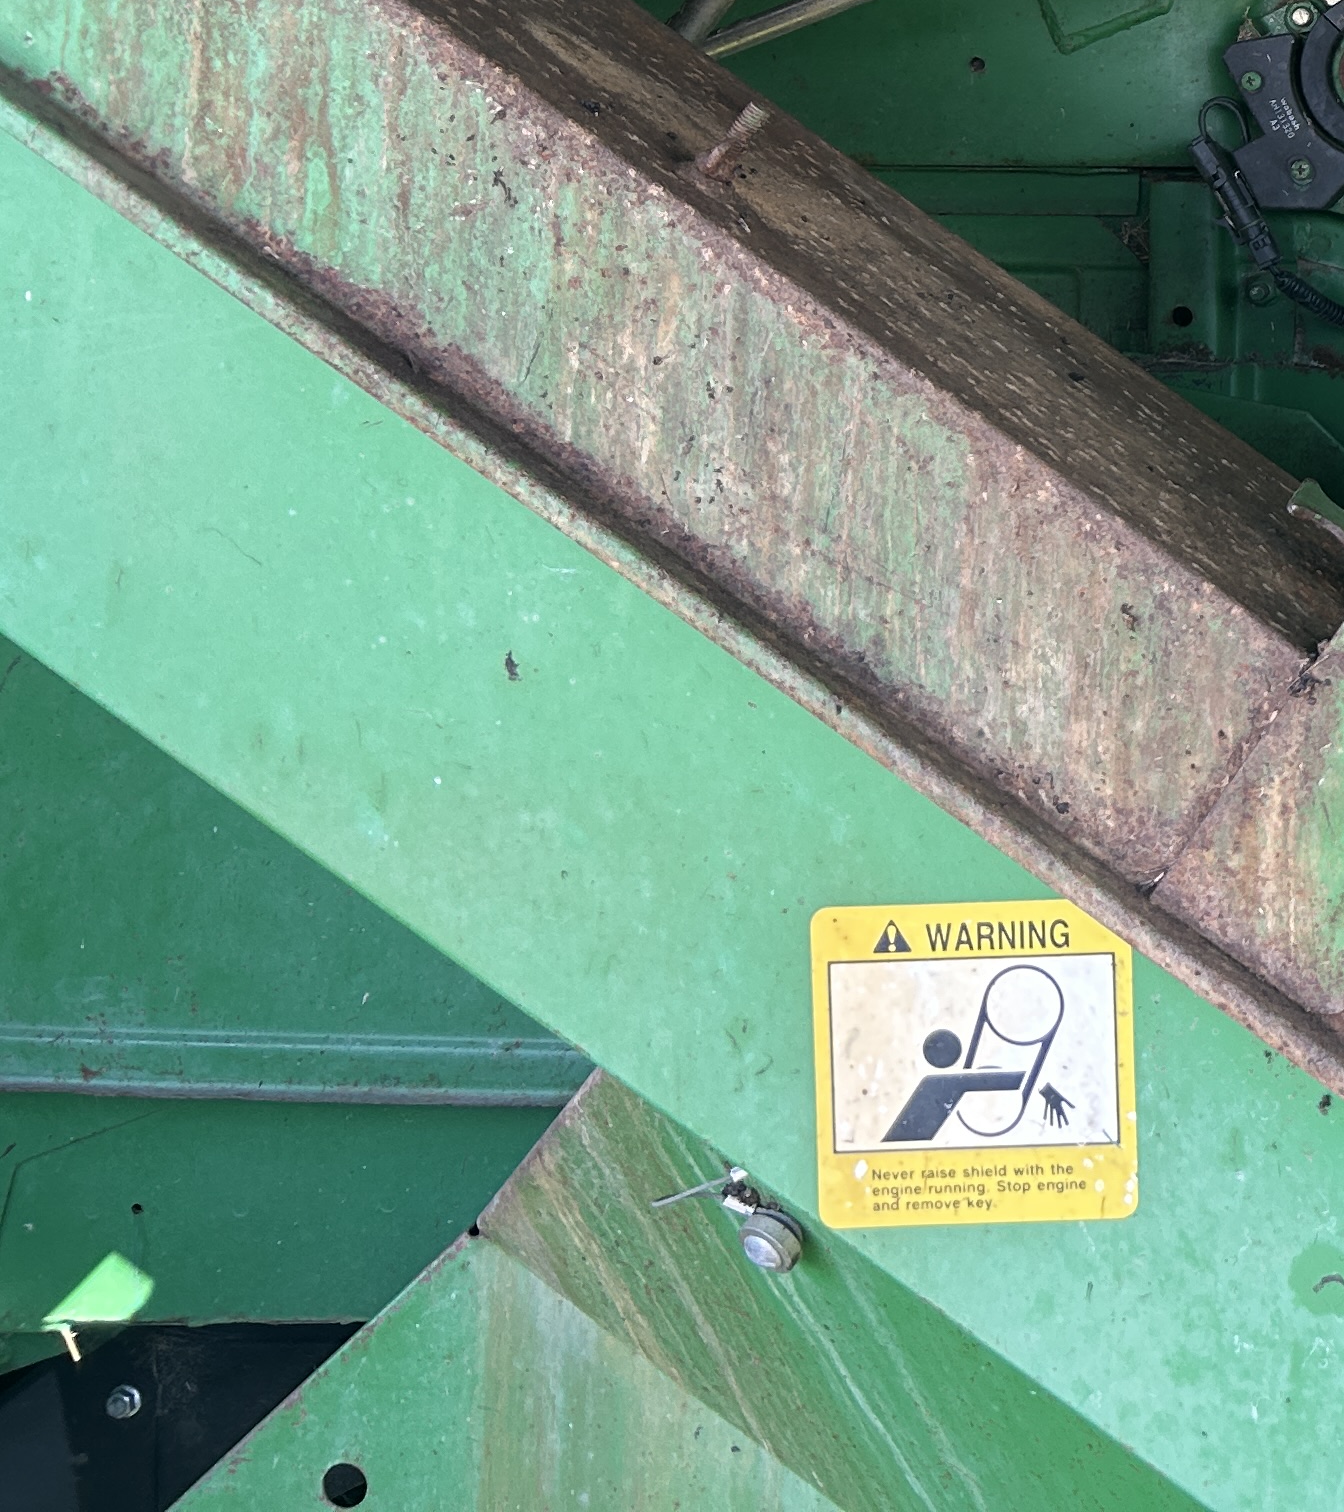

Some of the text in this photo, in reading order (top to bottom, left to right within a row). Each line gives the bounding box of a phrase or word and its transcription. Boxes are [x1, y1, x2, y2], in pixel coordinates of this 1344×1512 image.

[925, 918, 1070, 952] WARNING
[871, 1163, 1074, 1182] Never raise shield with the
[872, 1179, 1087, 1199] engine running. Stop engine
[872, 1197, 900, 1212] and
[905, 1199, 961, 1211] remove
